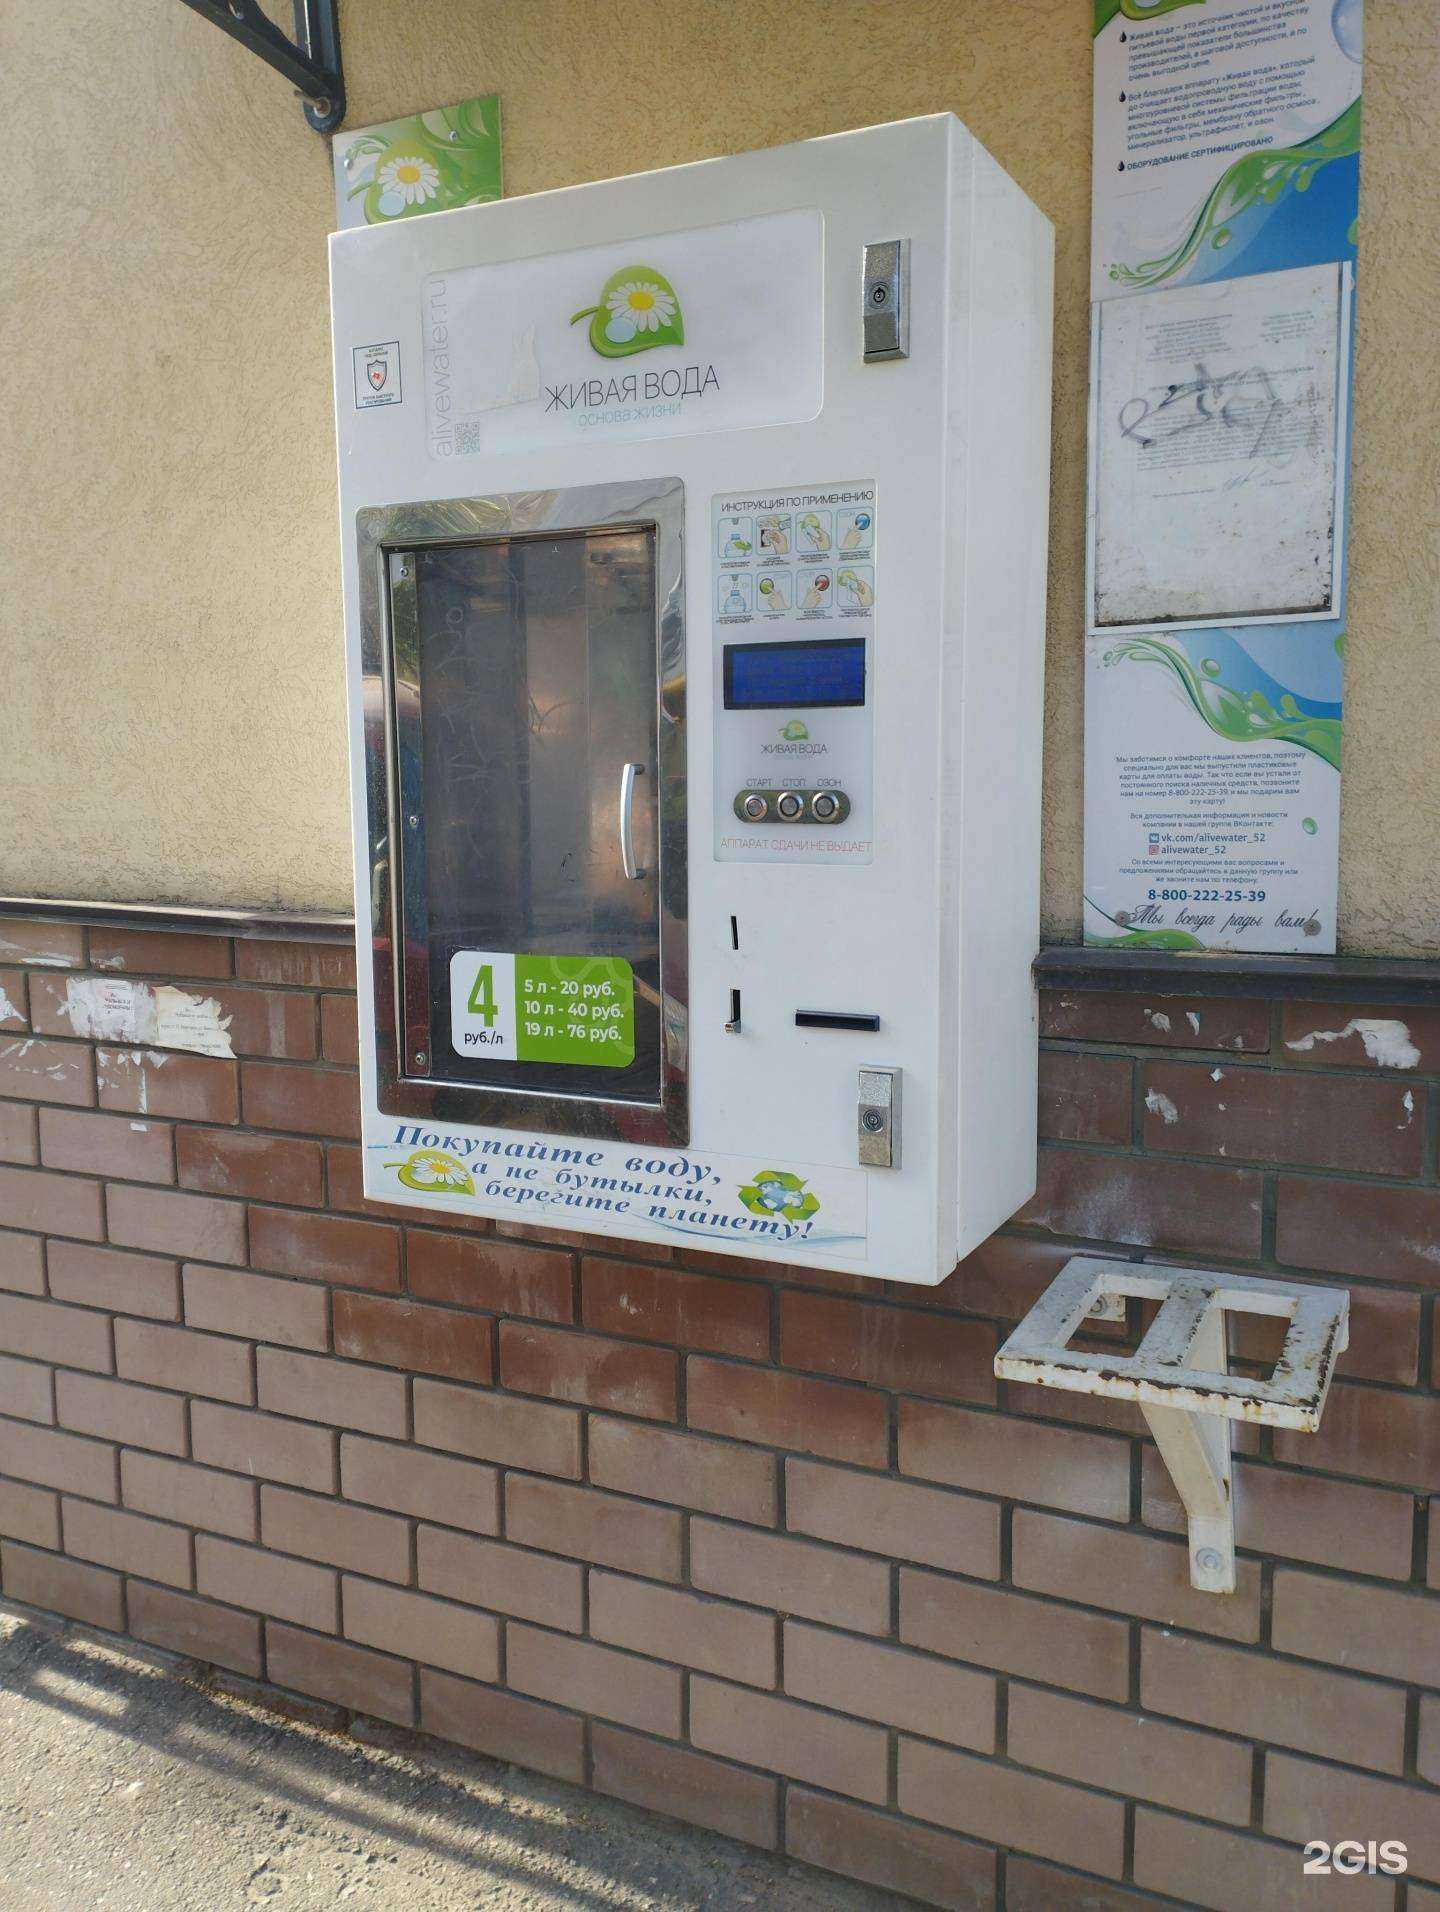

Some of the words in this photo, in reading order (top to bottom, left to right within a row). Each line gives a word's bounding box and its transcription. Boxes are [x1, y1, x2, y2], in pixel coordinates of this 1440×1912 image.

[1127, 151, 1189, 170] ОБОРУДОВАНИЕ
[1190, 136, 1273, 158] СЕРТИФИЦИРОВАНО
[430, 279, 453, 456] alivewater.ru
[544, 374, 637, 413] ЖИВАЯ
[645, 365, 720, 400] ВОДА
[721, 499, 785, 512] ИНСТРУКЦИЯ
[786, 498, 800, 508] ПО
[802, 490, 874, 506] ПРИМЕНЕНИЮ
[760, 743, 797, 754] ЖИВАЯ
[798, 743, 828, 755] ВОДА
[746, 778, 772, 787] СТАРТ
[782, 778, 806, 787] СТОП
[816, 778, 842, 787] ОЗОН
[720, 838, 769, 850] АППАРАТ
[770, 839, 808, 851] СДАЧИ
[810, 840, 825, 851] НЕ
[826, 841, 873, 853] ВЫДАЕТ
[1161, 832, 1266, 844] vk.com/alivewater_52
[1161, 844, 1227, 855] alivewater_52
[1148, 889, 1266, 902] 8-800-222-25-39
[1219, 912, 1264, 934] рады
[467, 964, 499, 1027] 4
[524, 979, 534, 993] 5
[536, 982, 547, 993] л
[560, 981, 579, 995] 20
[583, 981, 615, 999] руб.
[524, 1000, 541, 1014] 10
[544, 1003, 554, 1015] л
[567, 1002, 587, 1017] 40
[592, 1003, 624, 1020] руб.
[464, 1031, 503, 1045] руб./л
[524, 1021, 541, 1036] 19
[544, 1024, 554, 1037] л
[567, 1024, 586, 1039] 76
[590, 1025, 622, 1042] руб.
[394, 1125, 604, 1167] Покупайте
[625, 1156, 721, 1185] воду,
[471, 1161, 488, 1175] а
[506, 1165, 538, 1180] не
[555, 1168, 712, 1206] бутылки,
[485, 1180, 630, 1213] берегите
[648, 1204, 814, 1241] планету!
